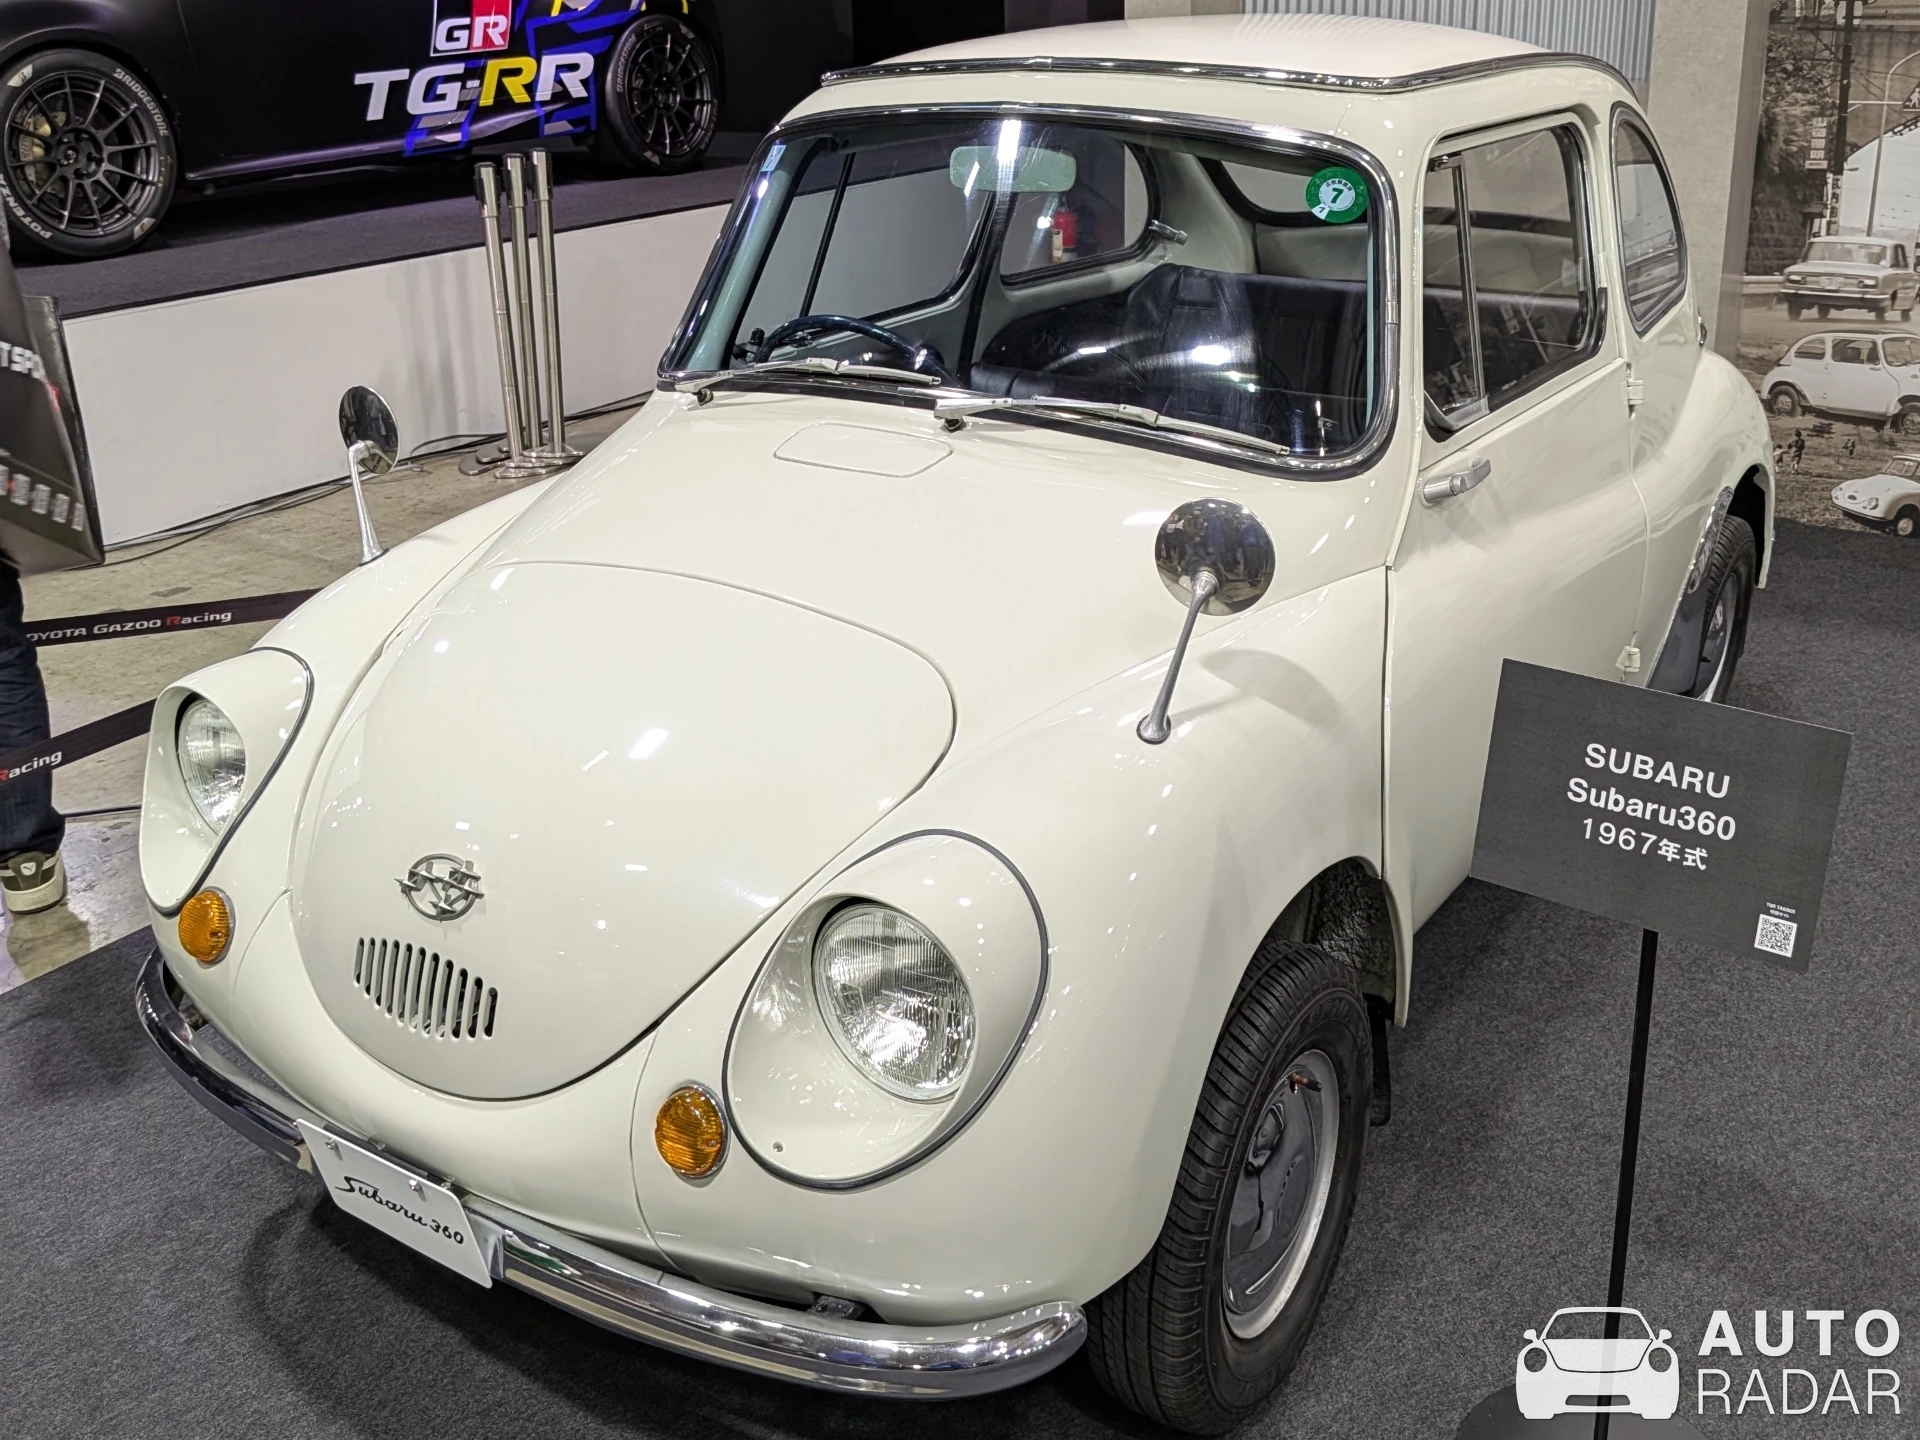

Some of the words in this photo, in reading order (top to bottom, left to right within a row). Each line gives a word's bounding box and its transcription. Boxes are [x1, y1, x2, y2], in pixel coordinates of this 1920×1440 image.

[435, 15, 507, 50] GR
[112, 68, 170, 137] BRIDGESTONE
[354, 52, 595, 121] TG-RR
[1331, 187, 1344, 204] 7
[26, 627, 87, 642] OYOTA
[93, 618, 162, 635] GAZOO
[166, 611, 233, 627] Racing
[0, 751, 62, 782] Racing
[1584, 743, 1731, 799] SUBARU
[1566, 777, 1736, 841] Subaru360
[1582, 817, 1708, 871] 1967年式
